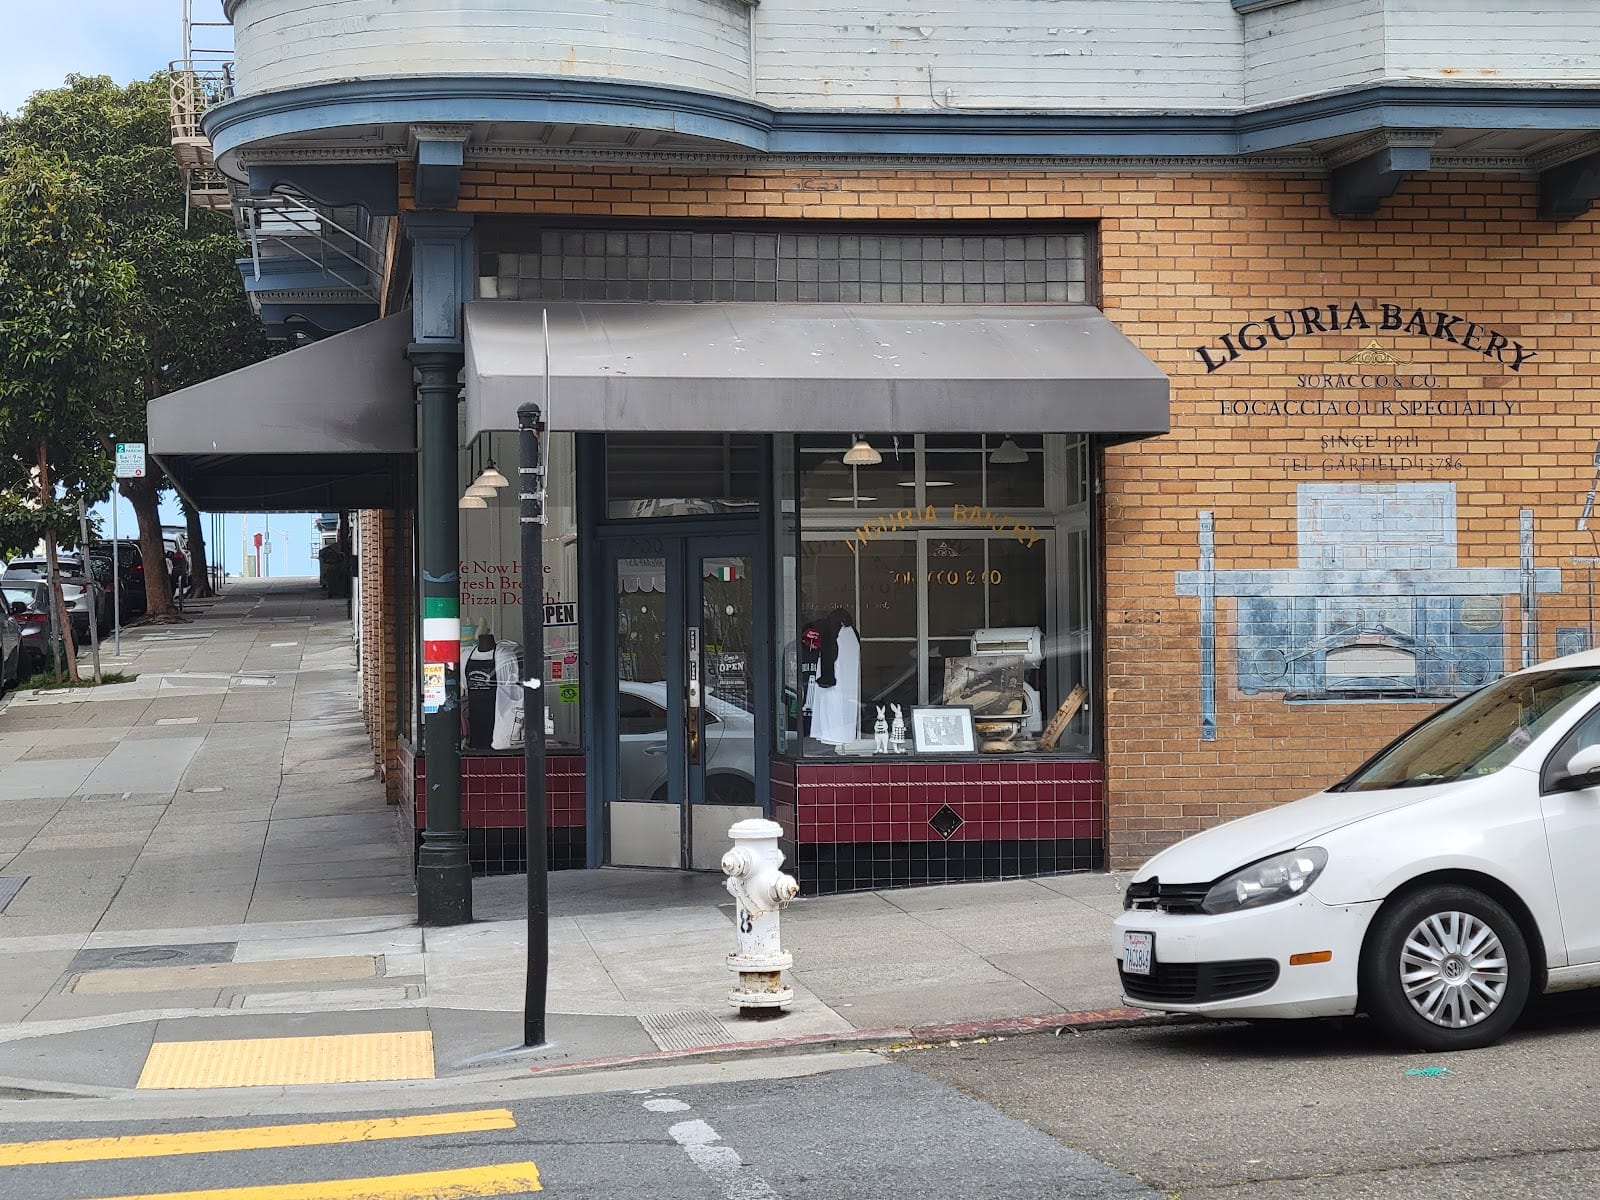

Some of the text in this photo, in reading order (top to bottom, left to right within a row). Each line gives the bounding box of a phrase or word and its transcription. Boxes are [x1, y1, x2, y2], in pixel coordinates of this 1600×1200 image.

[1196, 302, 1538, 374] LIGURIA BAKERY
[1297, 374, 1441, 388] SORACCO & CO.
[1221, 400, 1515, 416] FOCACCIA OUR SPECIALTY
[1321, 434, 1419, 449] SINCE 1911
[1322, 457, 1413, 471] GARFIELD
[472, 561, 509, 573] Now
[459, 577, 495, 589] resh
[461, 592, 497, 605] Pizza
[542, 604, 575, 623] PEN
[719, 661, 745, 672] OPEN
